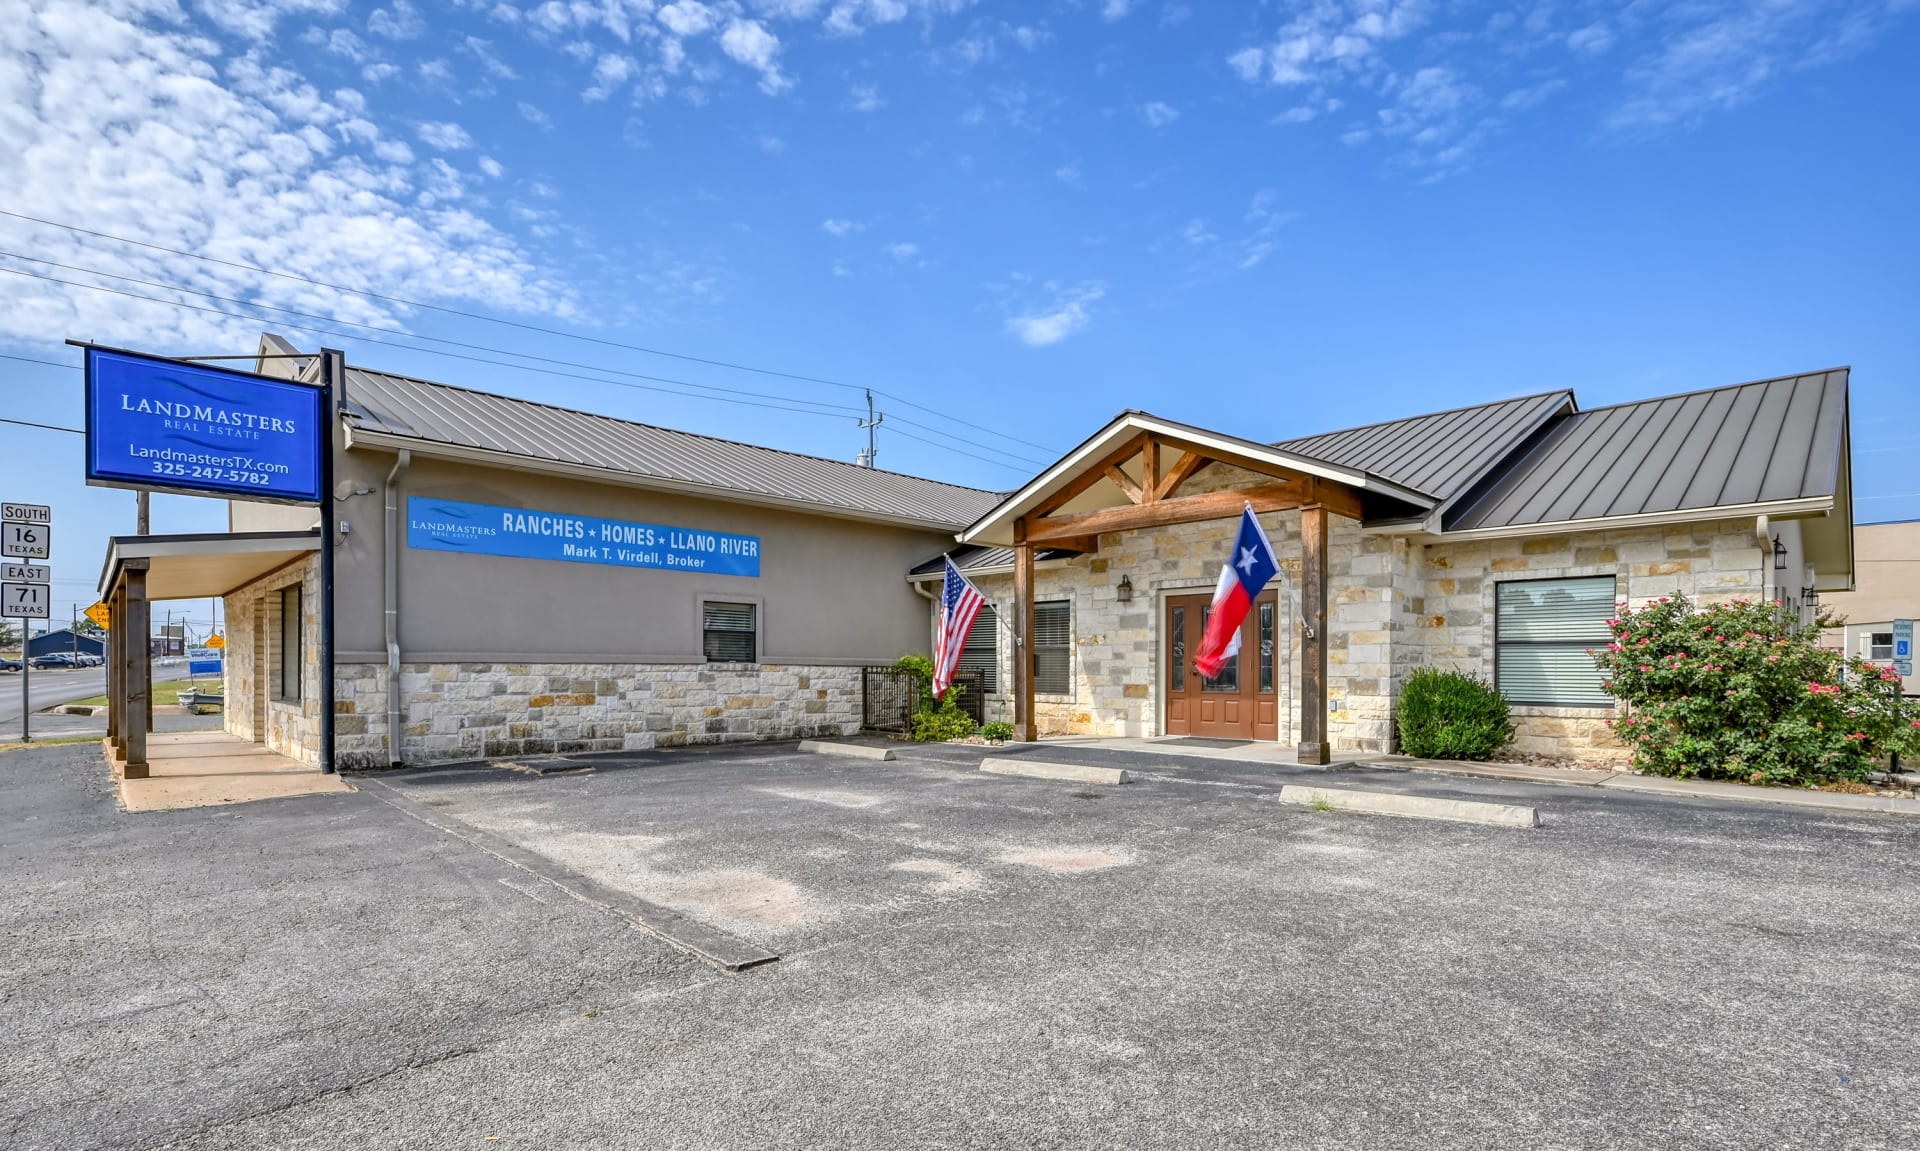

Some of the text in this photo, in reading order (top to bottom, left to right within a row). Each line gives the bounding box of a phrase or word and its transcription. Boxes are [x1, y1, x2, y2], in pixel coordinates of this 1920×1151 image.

[121, 394, 296, 434] LANDMASTERS
[164, 419, 260, 440] REAL ESTATE
[130, 443, 289, 474] LandmastersTX.com
[152, 461, 270, 485] 325-247-5782
[5, 506, 47, 520] SOUTH
[16, 528, 36, 543] 16
[412, 520, 496, 536] LANDMASTERS
[503, 512, 757, 557] RANCHES HOMES LLANO RIVER
[453, 532, 478, 540] ESTATE
[8, 545, 43, 554] TEXAS
[563, 544, 705, 568] Mark T. Virdell, Broker
[9, 567, 43, 579] EAST
[16, 588, 37, 603] 71
[8, 605, 43, 614] TEXAS
